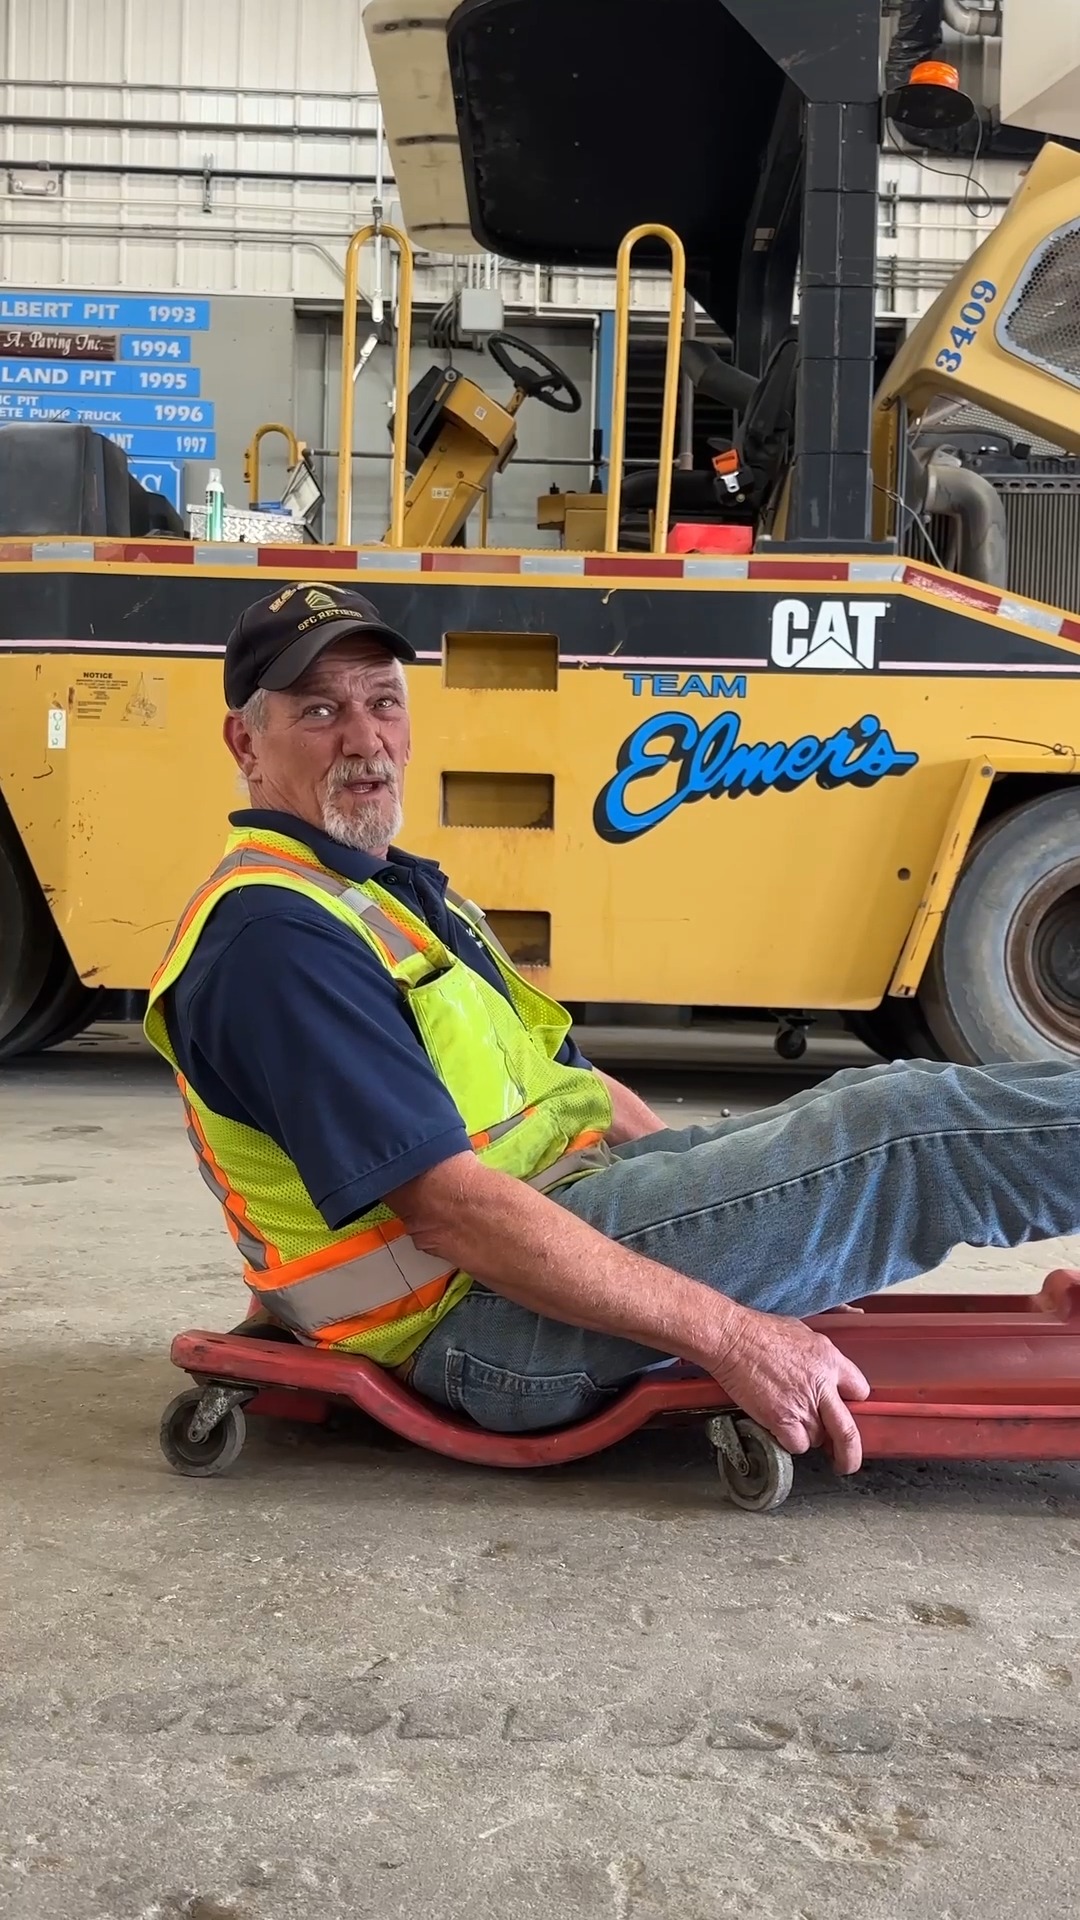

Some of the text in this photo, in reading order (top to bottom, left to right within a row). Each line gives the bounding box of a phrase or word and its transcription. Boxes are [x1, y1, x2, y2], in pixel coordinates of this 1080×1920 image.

[83, 303, 120, 320] PIT
[149, 306, 197, 323] 1993
[935, 280, 997, 373] 3409
[29, 331, 71, 356] Paving
[76, 334, 104, 351] Inc.
[131, 340, 181, 357] 1994
[1, 367, 188, 389] LAND PIT 1995
[17, 396, 39, 406] PIT
[30, 408, 70, 419] PUMP
[77, 410, 122, 421] TRUCK
[155, 405, 204, 422] 1996
[101, 432, 208, 453] ANT 1997
[770, 598, 886, 670] CAT
[623, 673, 747, 699] TEAM
[593, 711, 919, 844] Elmer's
